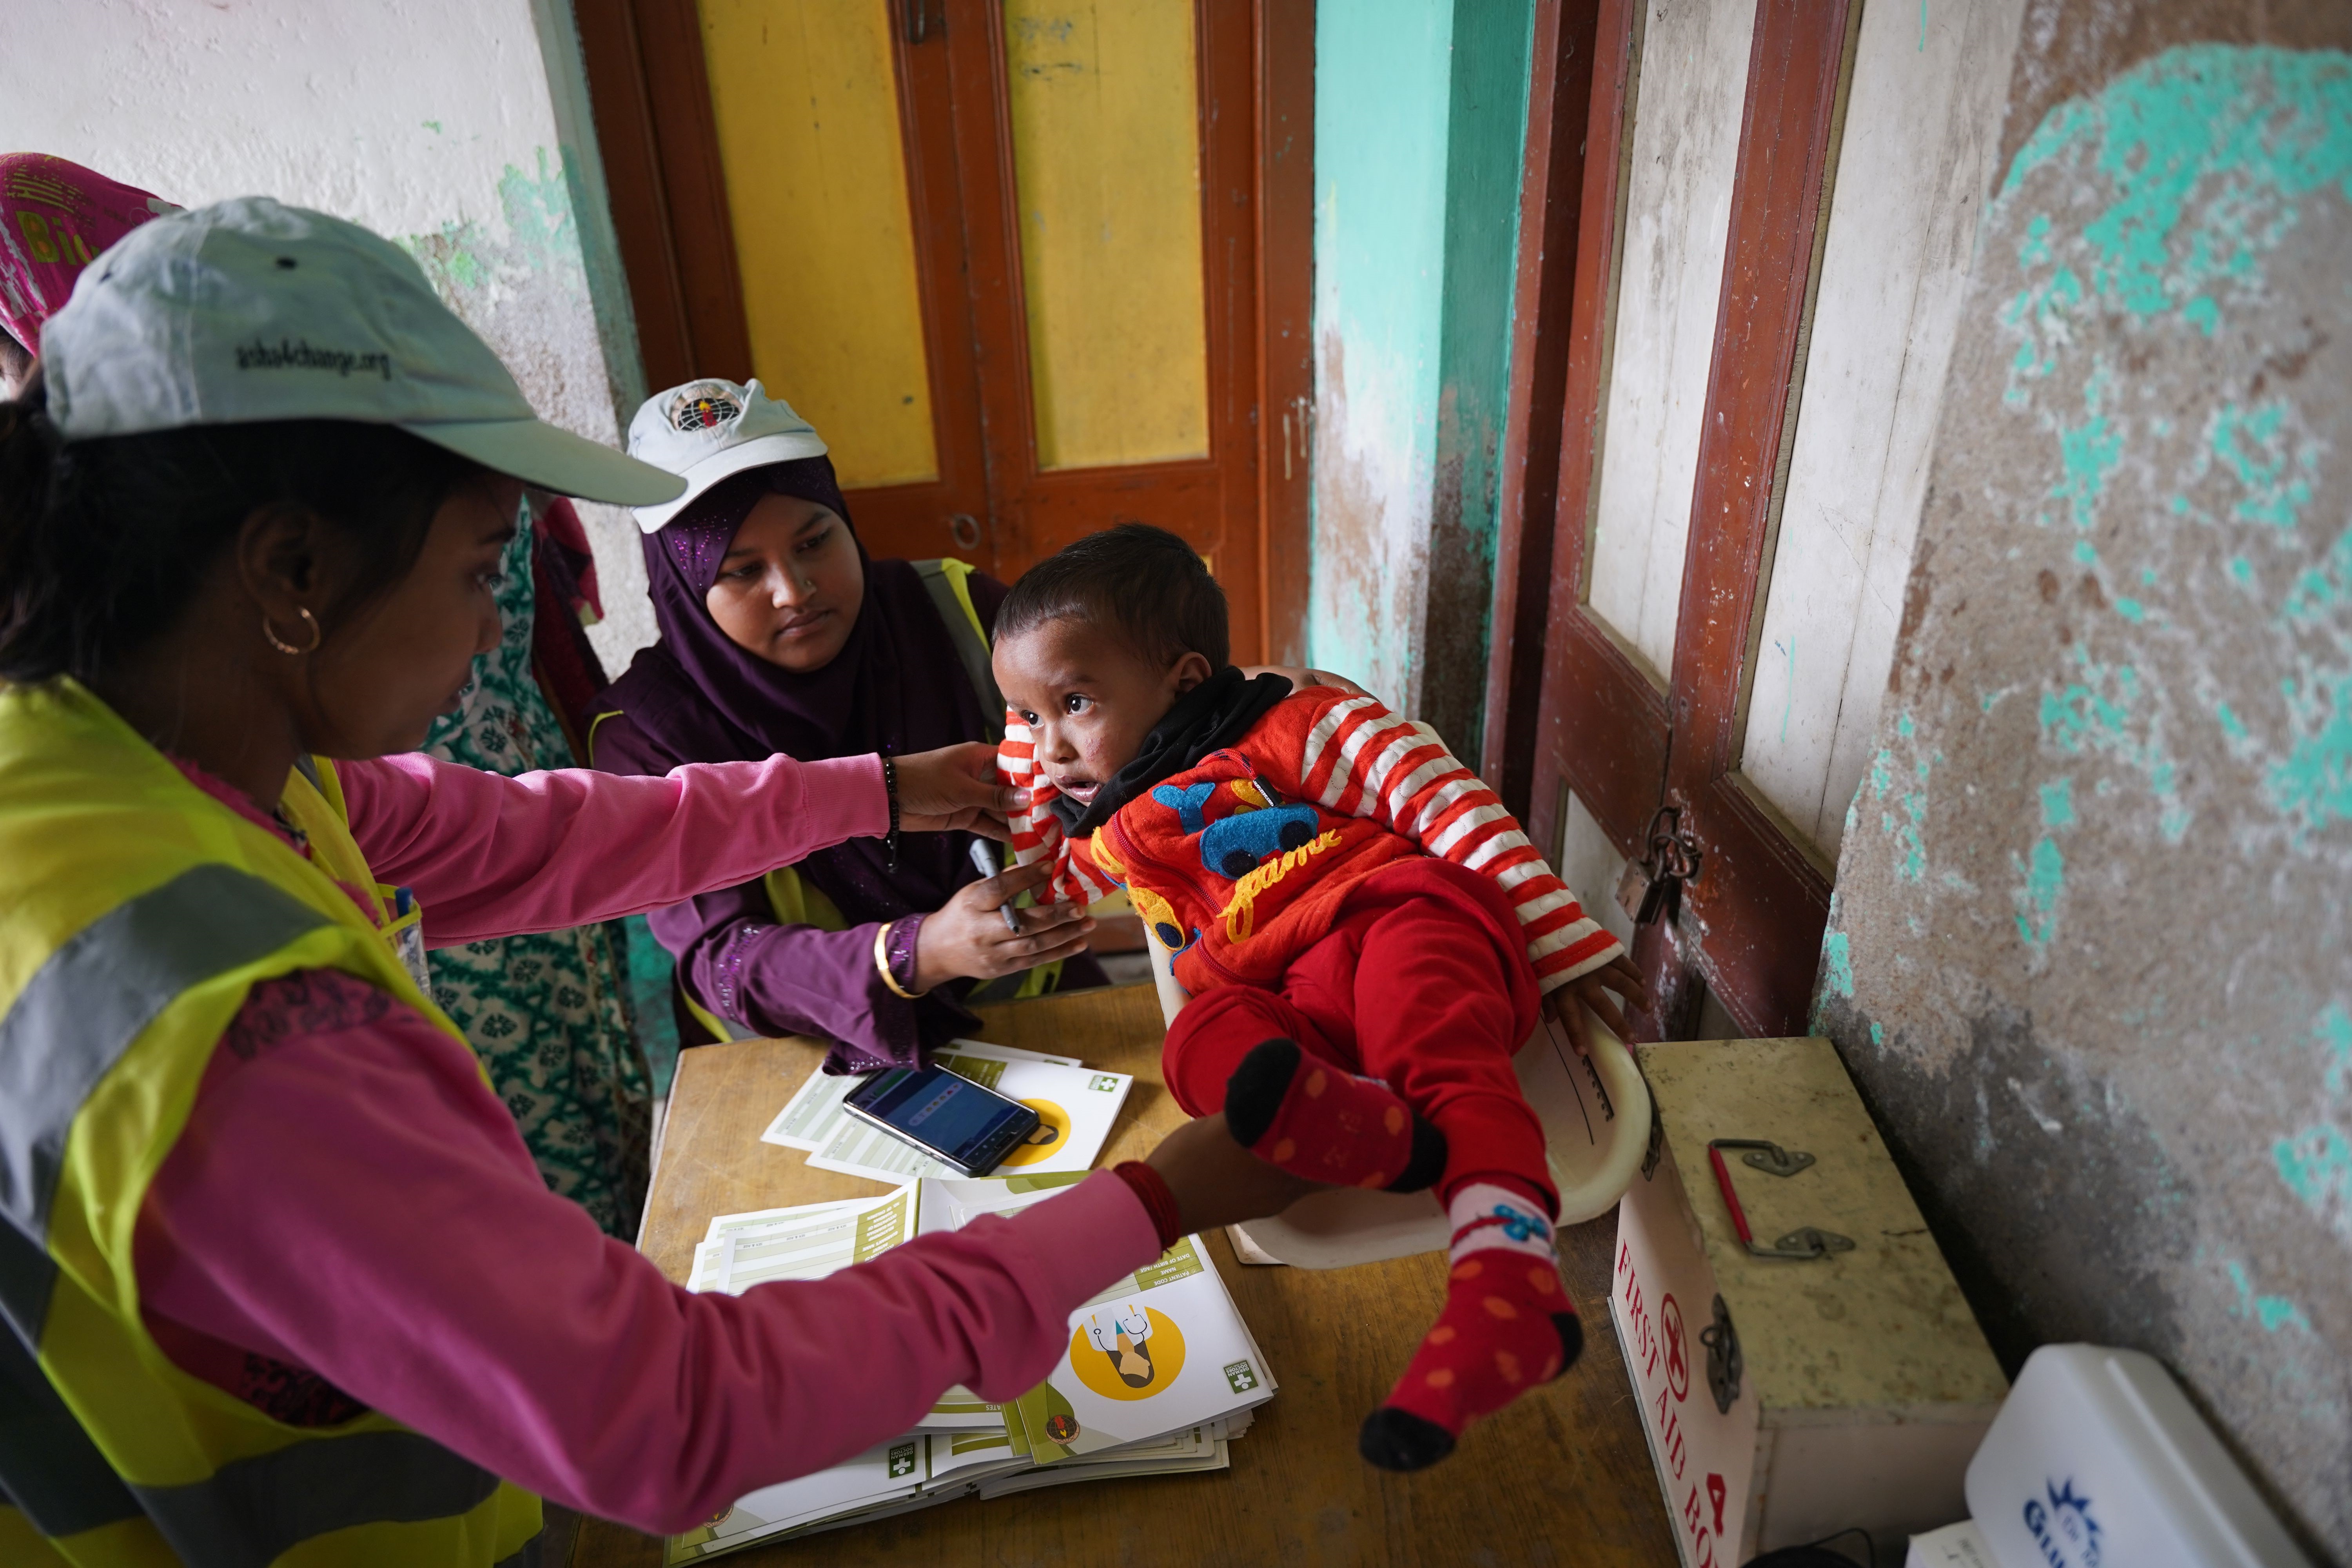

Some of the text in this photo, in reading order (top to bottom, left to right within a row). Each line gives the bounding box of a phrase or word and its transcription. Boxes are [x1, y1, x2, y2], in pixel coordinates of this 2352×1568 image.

[867, 1210, 886, 1220] CHILDREN
[873, 1210, 893, 1223] GUARDIAN
[874, 1213, 897, 1229] OCCUPATION
[866, 1219, 897, 1237] WITH GUARDIAN
[868, 1225, 895, 1241] RELATIONSHIP
[862, 1243, 875, 1252] NAME
[873, 1242, 888, 1253] PATIENT
[1176, 1253, 1190, 1261] DATE
[1153, 1260, 1168, 1269] BIRTH
[1160, 1267, 1176, 1275] NAME
[1169, 1270, 1189, 1281] PATIENT
[1226, 1363, 1248, 1373] DOCTORS
[1228, 1367, 1249, 1377] GERMAN
[1617, 1238, 1719, 1568] FIRST AID BO
[891, 1446, 913, 1455] DOCTORS
[891, 1450, 913, 1460] GERMAN
